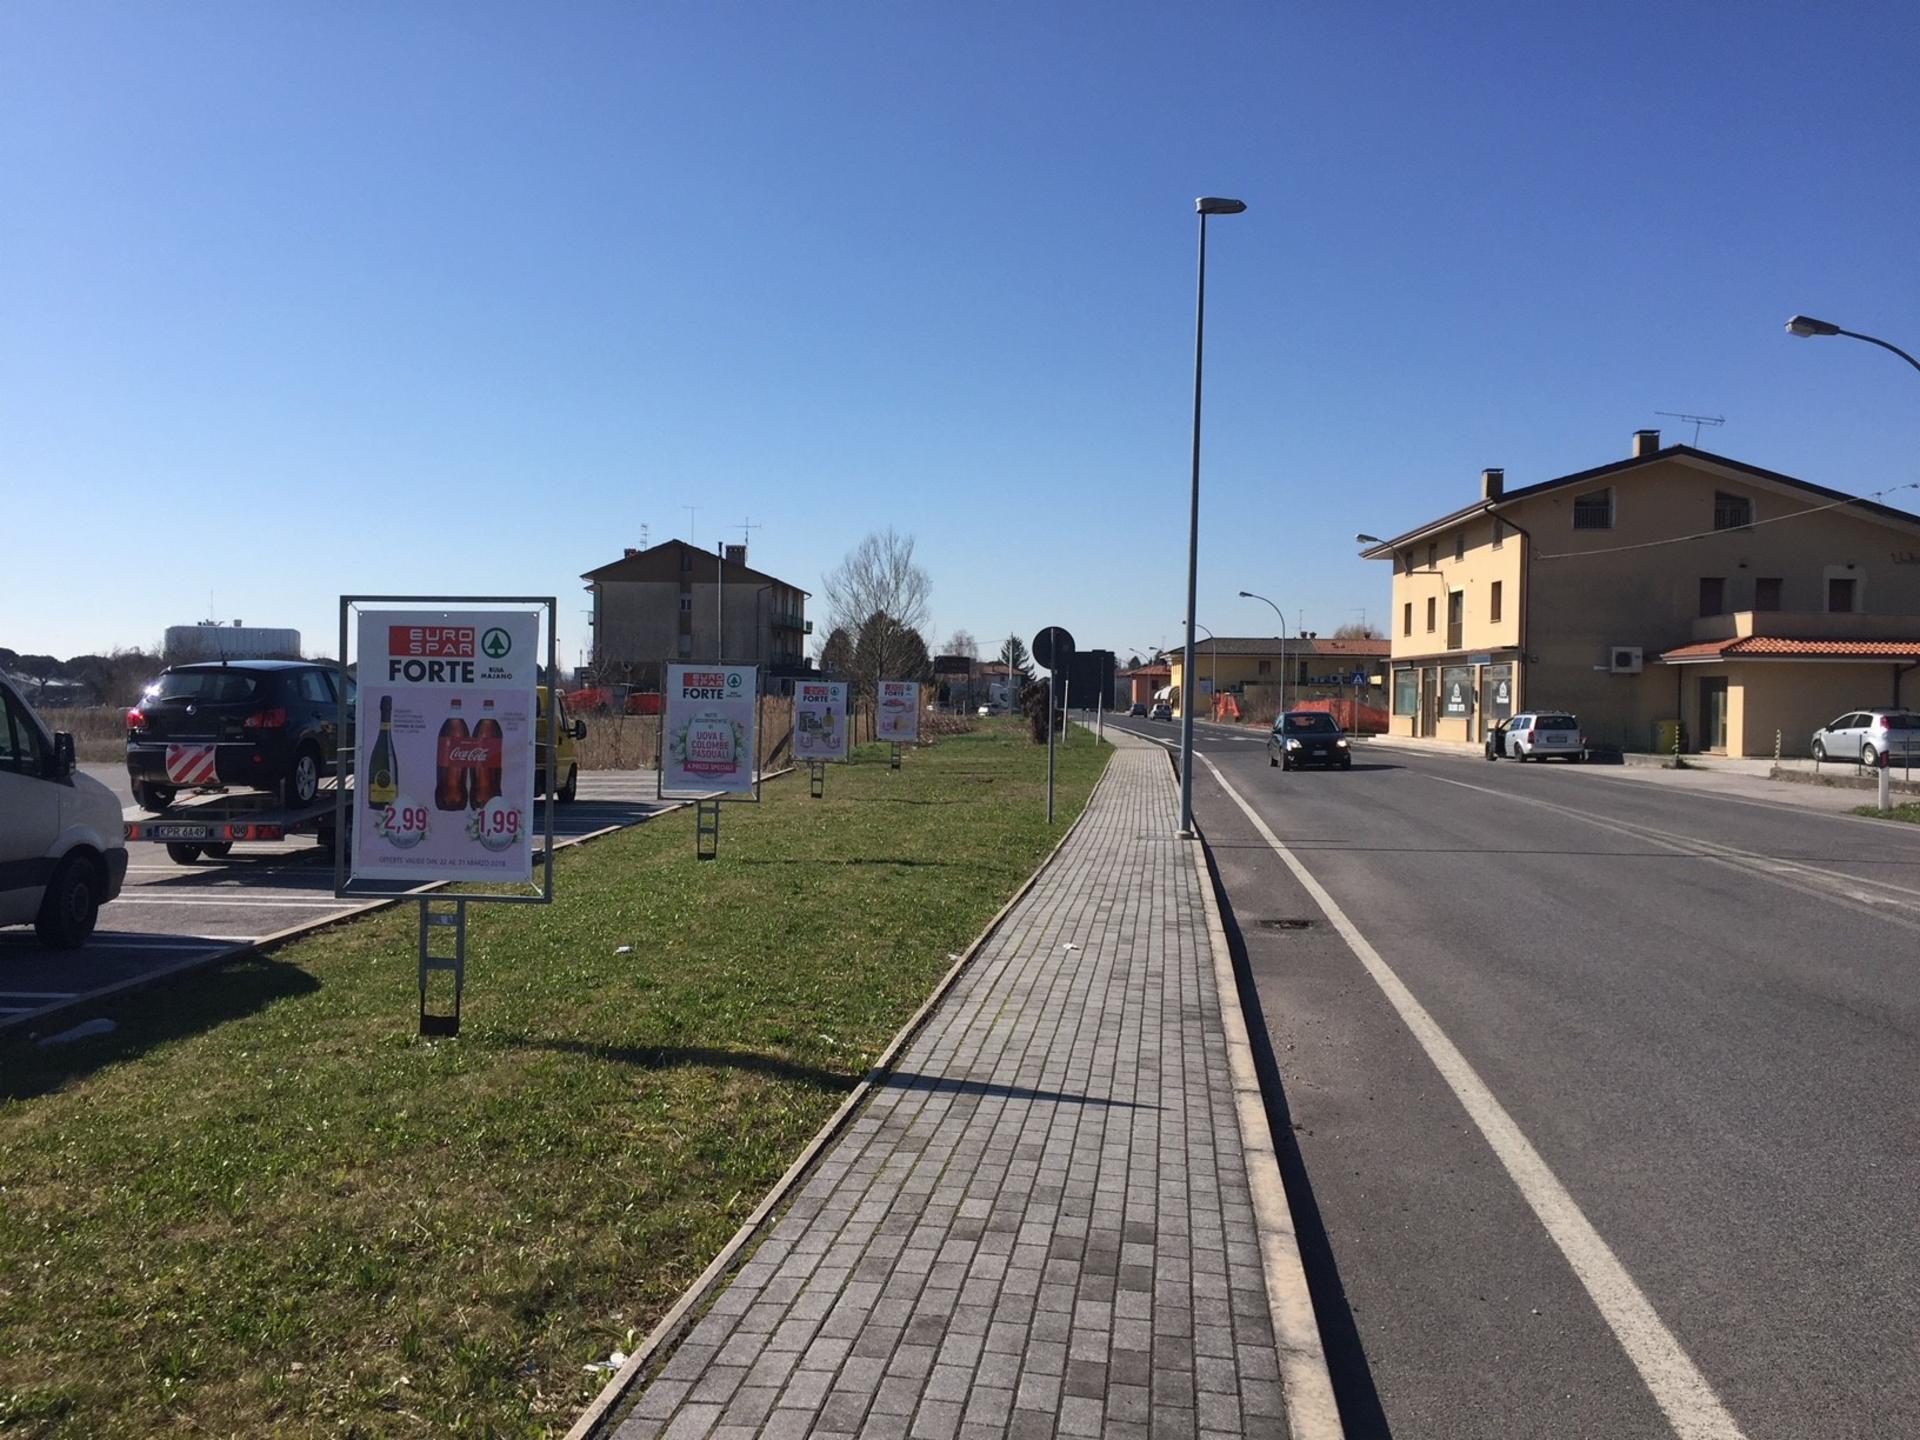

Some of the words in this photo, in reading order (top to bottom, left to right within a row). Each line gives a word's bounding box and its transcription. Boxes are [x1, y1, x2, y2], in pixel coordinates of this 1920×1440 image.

[409, 629, 473, 641] EURO
[409, 642, 473, 655] SPAR
[389, 659, 475, 683] FORTE
[682, 688, 724, 700] FORTE
[803, 695, 828, 703] FORTE
[696, 731, 717, 740] UOVA
[719, 732, 725, 740] E
[691, 740, 729, 750] COLOMBE
[691, 750, 729, 759] PASQUALI
[383, 807, 427, 834] 2,99
[478, 810, 519, 837] 1,99
[160, 826, 180, 837] KPR
